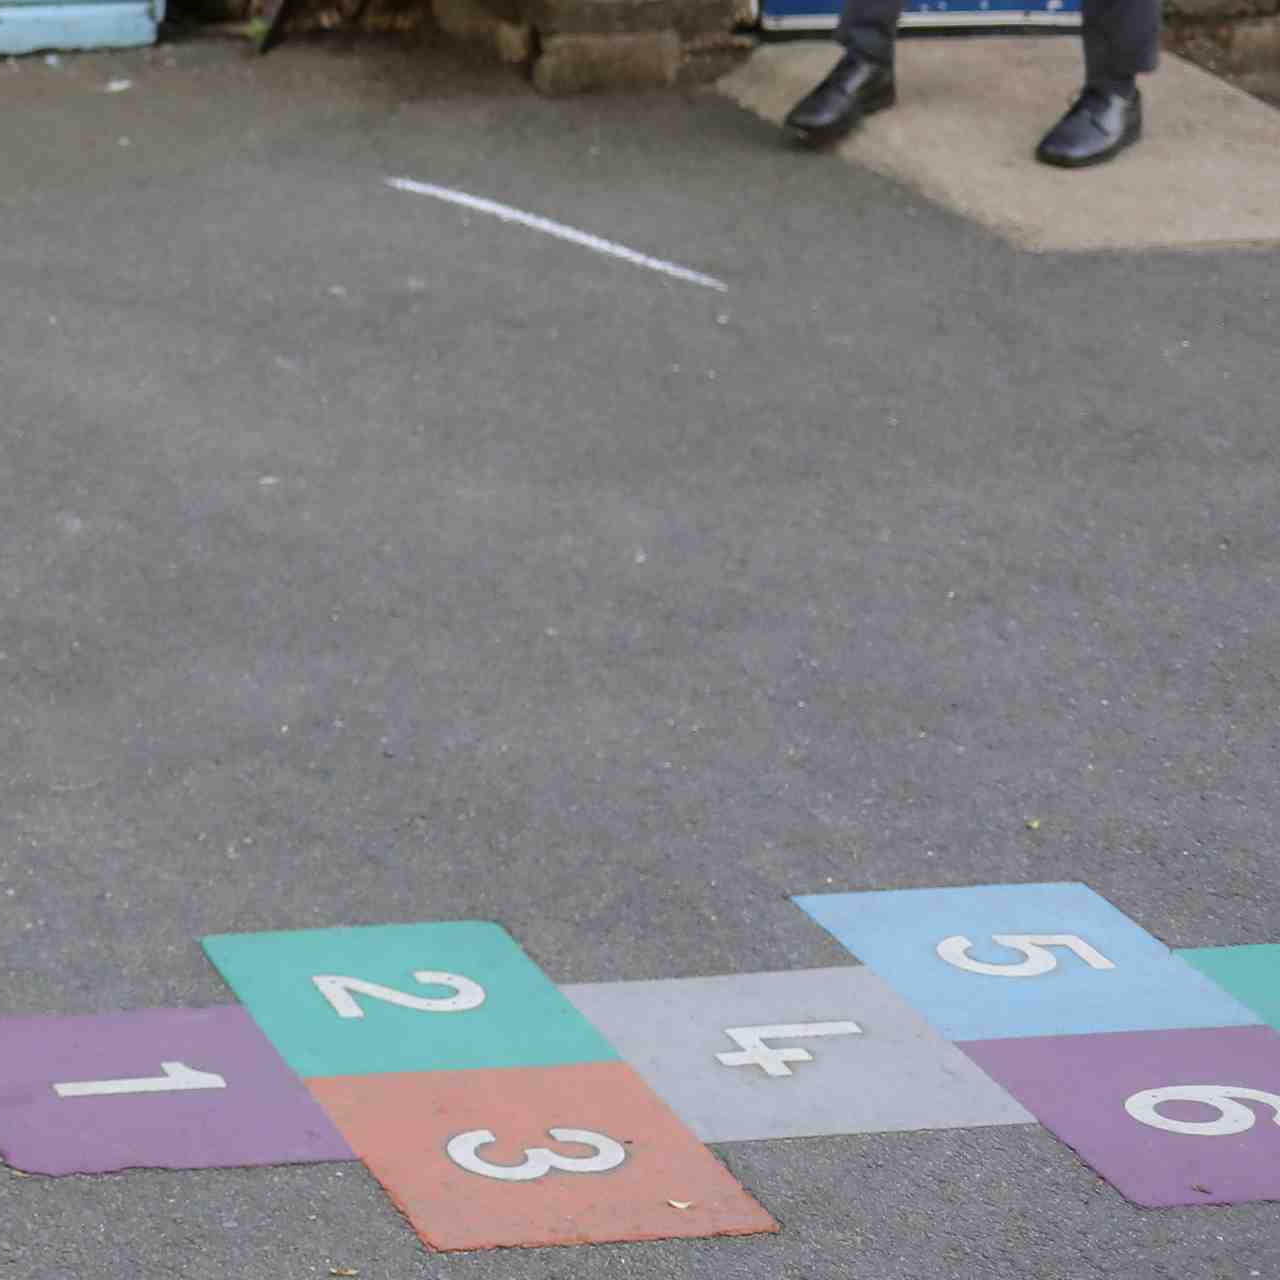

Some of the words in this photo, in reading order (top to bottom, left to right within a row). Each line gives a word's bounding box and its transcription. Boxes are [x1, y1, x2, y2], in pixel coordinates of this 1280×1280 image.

[935, 933, 1117, 977] 5
[311, 970, 487, 1020] 2
[714, 1020, 864, 1077] 4
[52, 1061, 227, 1097] 1
[1123, 1084, 1280, 1136] 6
[446, 1128, 626, 1181] 3
